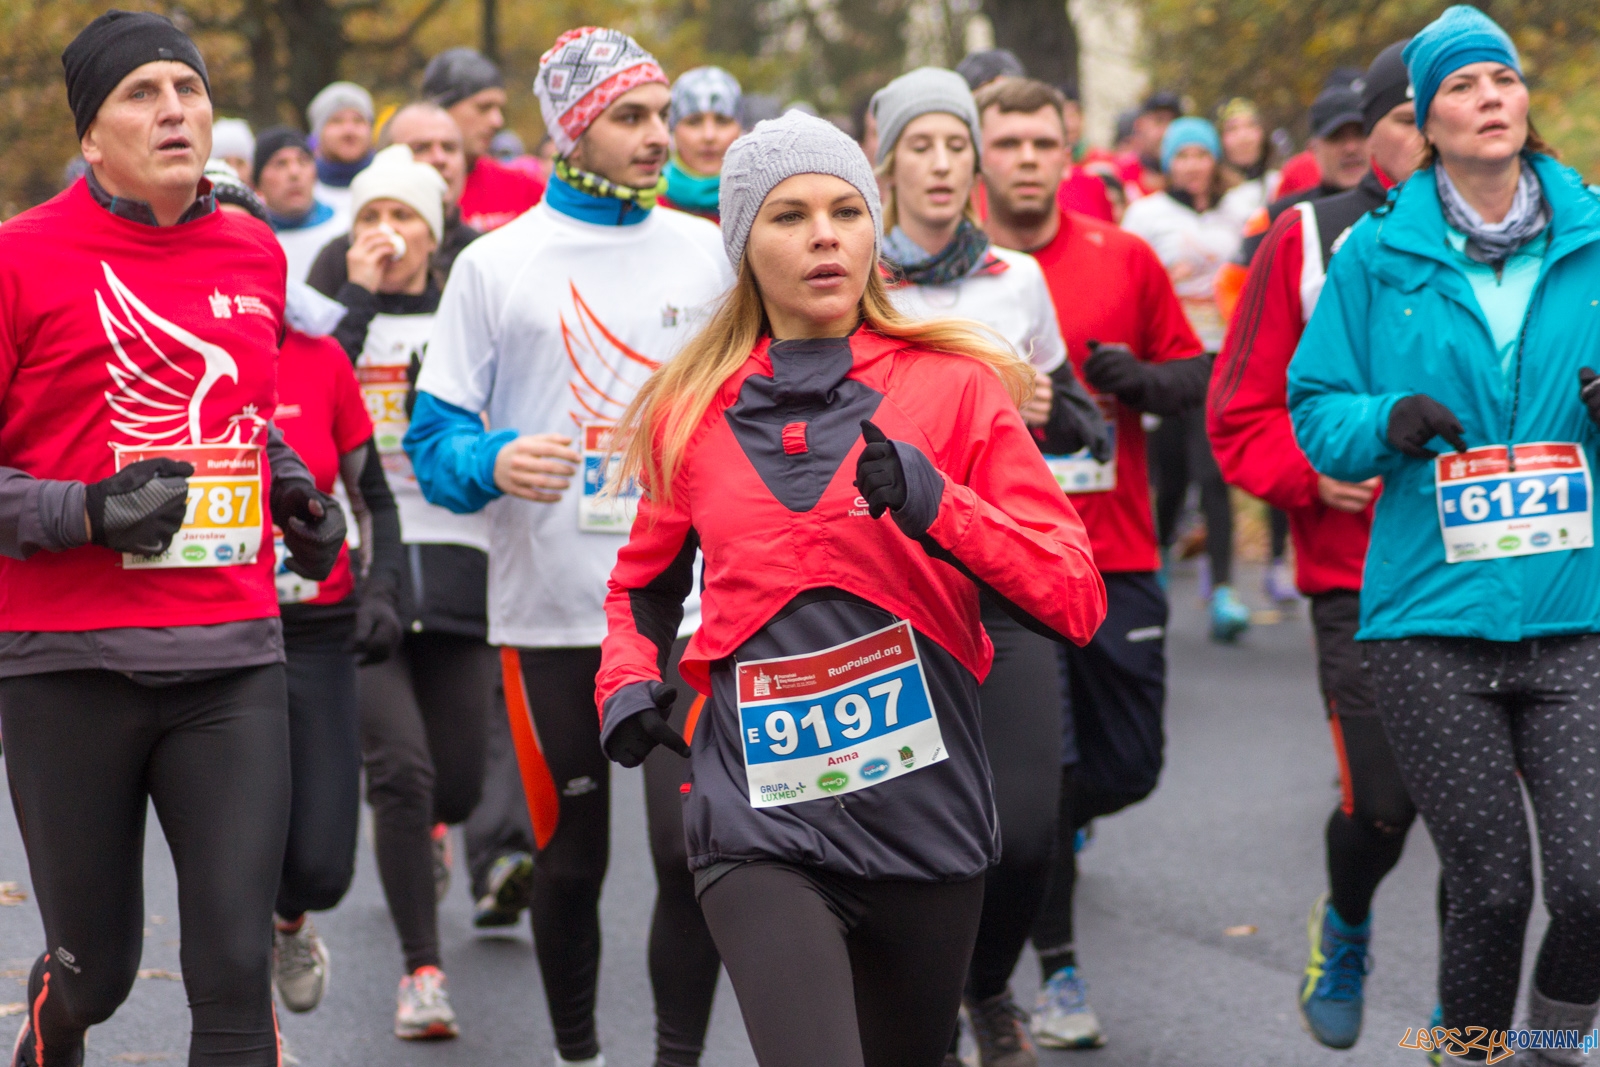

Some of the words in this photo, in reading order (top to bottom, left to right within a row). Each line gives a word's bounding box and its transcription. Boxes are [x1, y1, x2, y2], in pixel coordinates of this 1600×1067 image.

[1443, 499, 1457, 513] E
[1460, 476, 1569, 521] 6121
[828, 644, 902, 677] RunPoland.org
[747, 727, 760, 744] E
[765, 678, 903, 756] 9197
[827, 752, 859, 766] Anna
[760, 782, 789, 794] GRUPA
[761, 790, 797, 802] LUXMED
